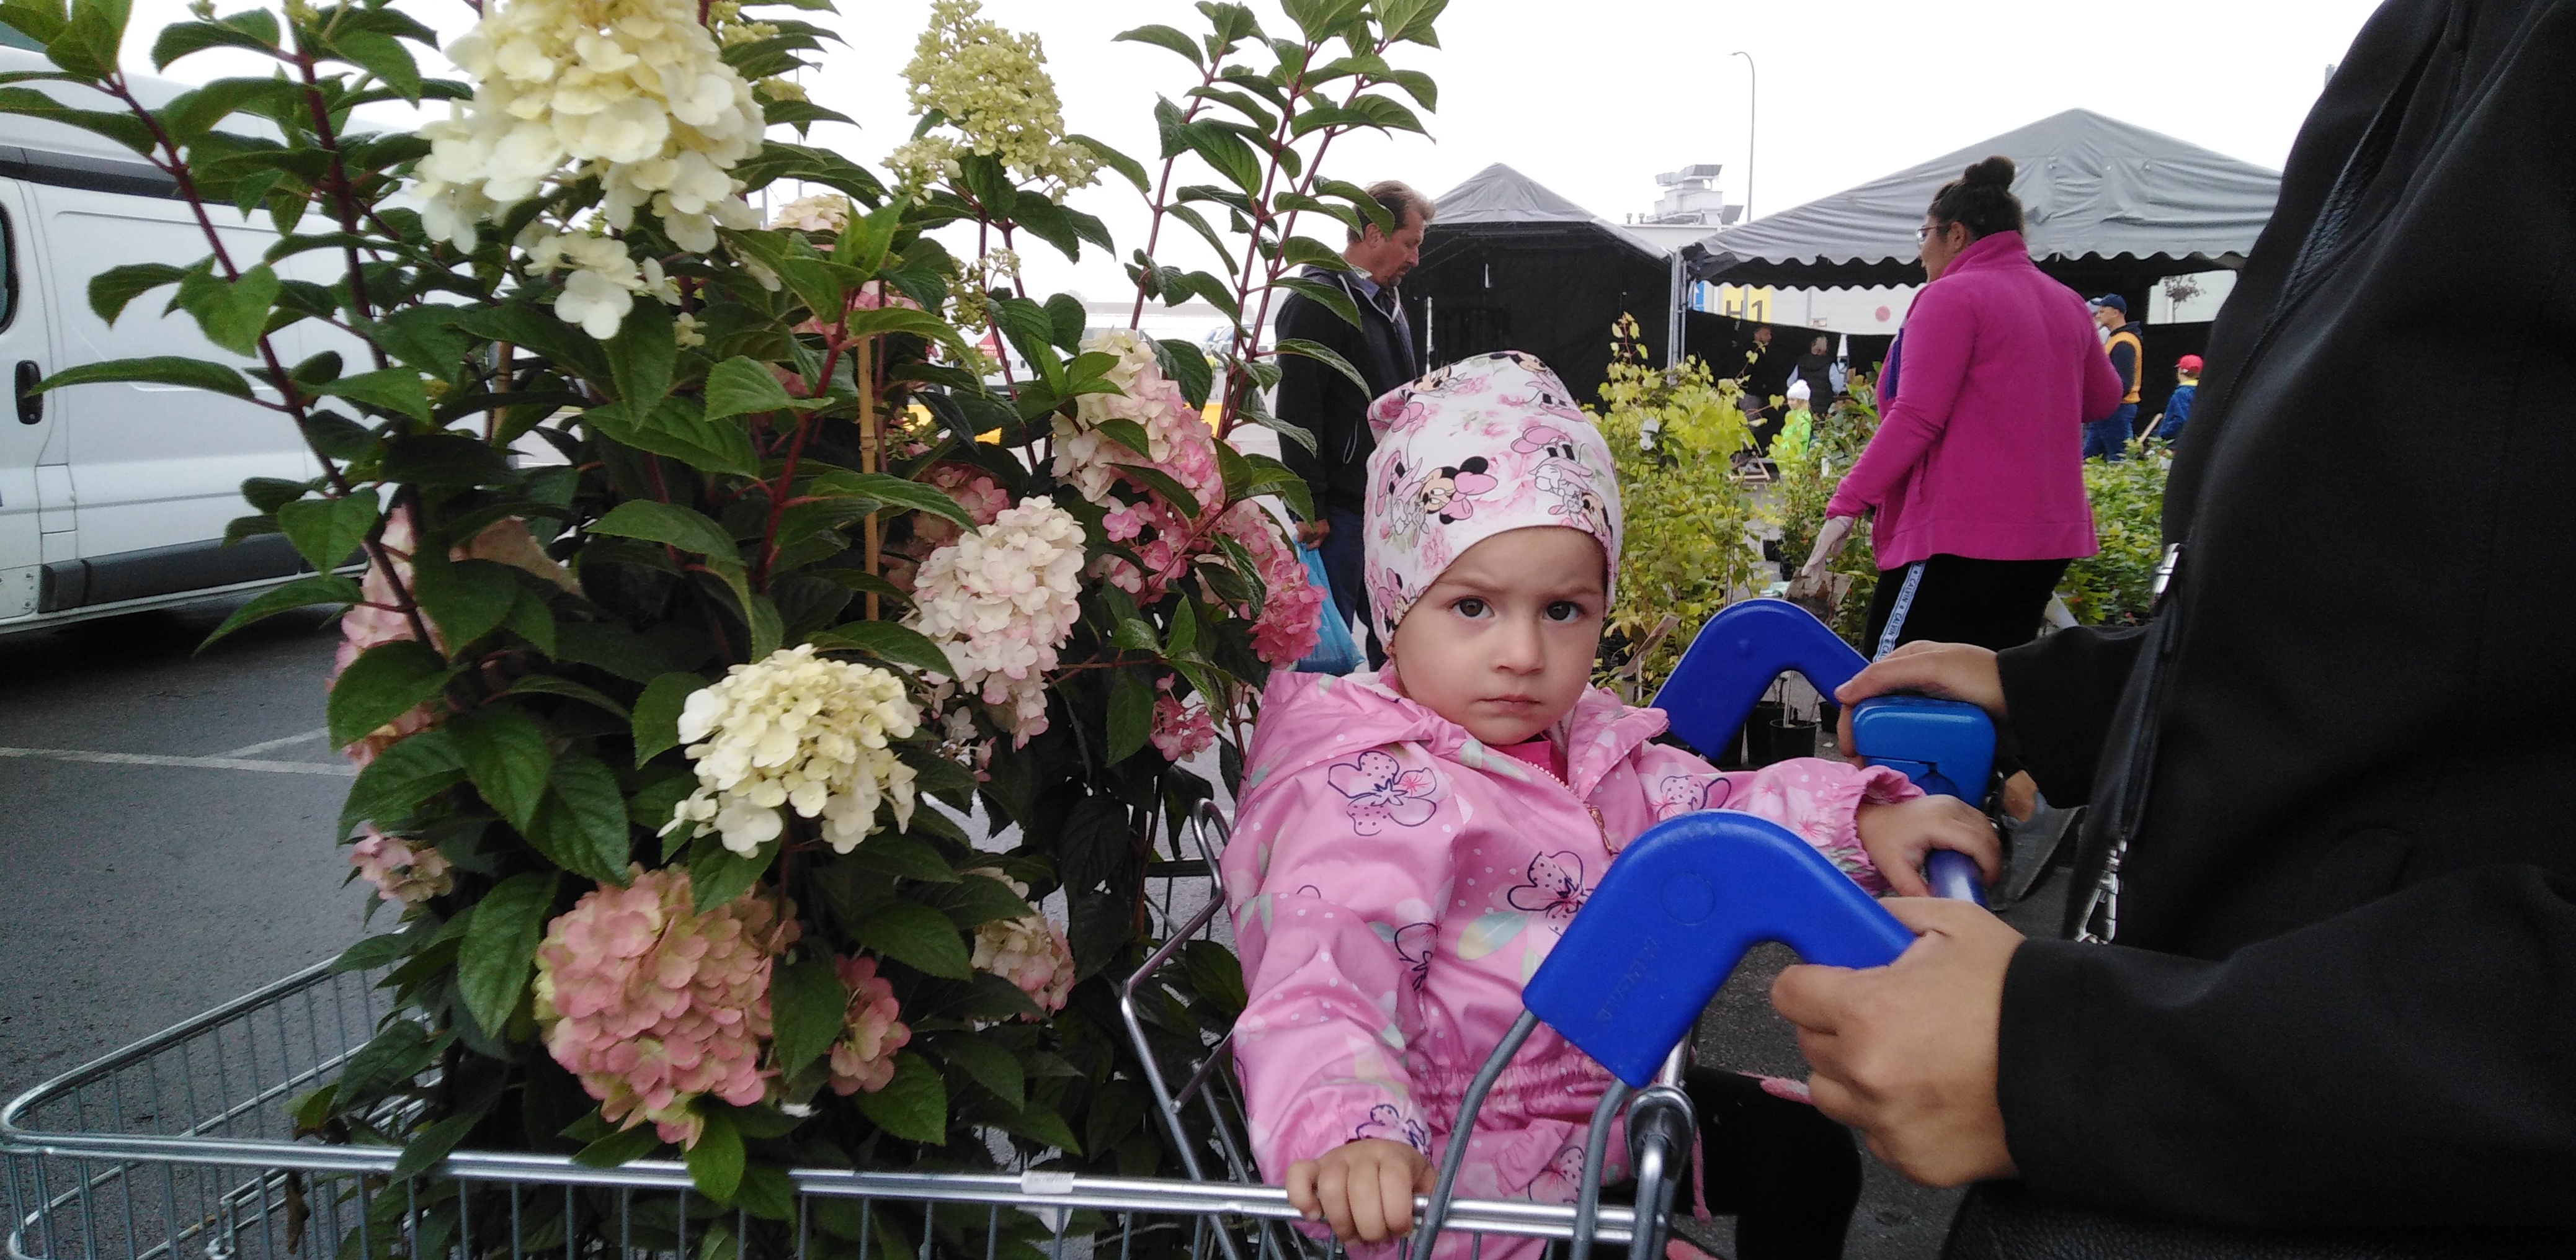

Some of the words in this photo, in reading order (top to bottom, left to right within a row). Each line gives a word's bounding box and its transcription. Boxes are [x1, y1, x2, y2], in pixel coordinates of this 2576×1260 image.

[1726, 300, 1763, 322] H1
[1902, 578, 1916, 604] CALVIN
[1887, 612, 1902, 637] CALVIN
